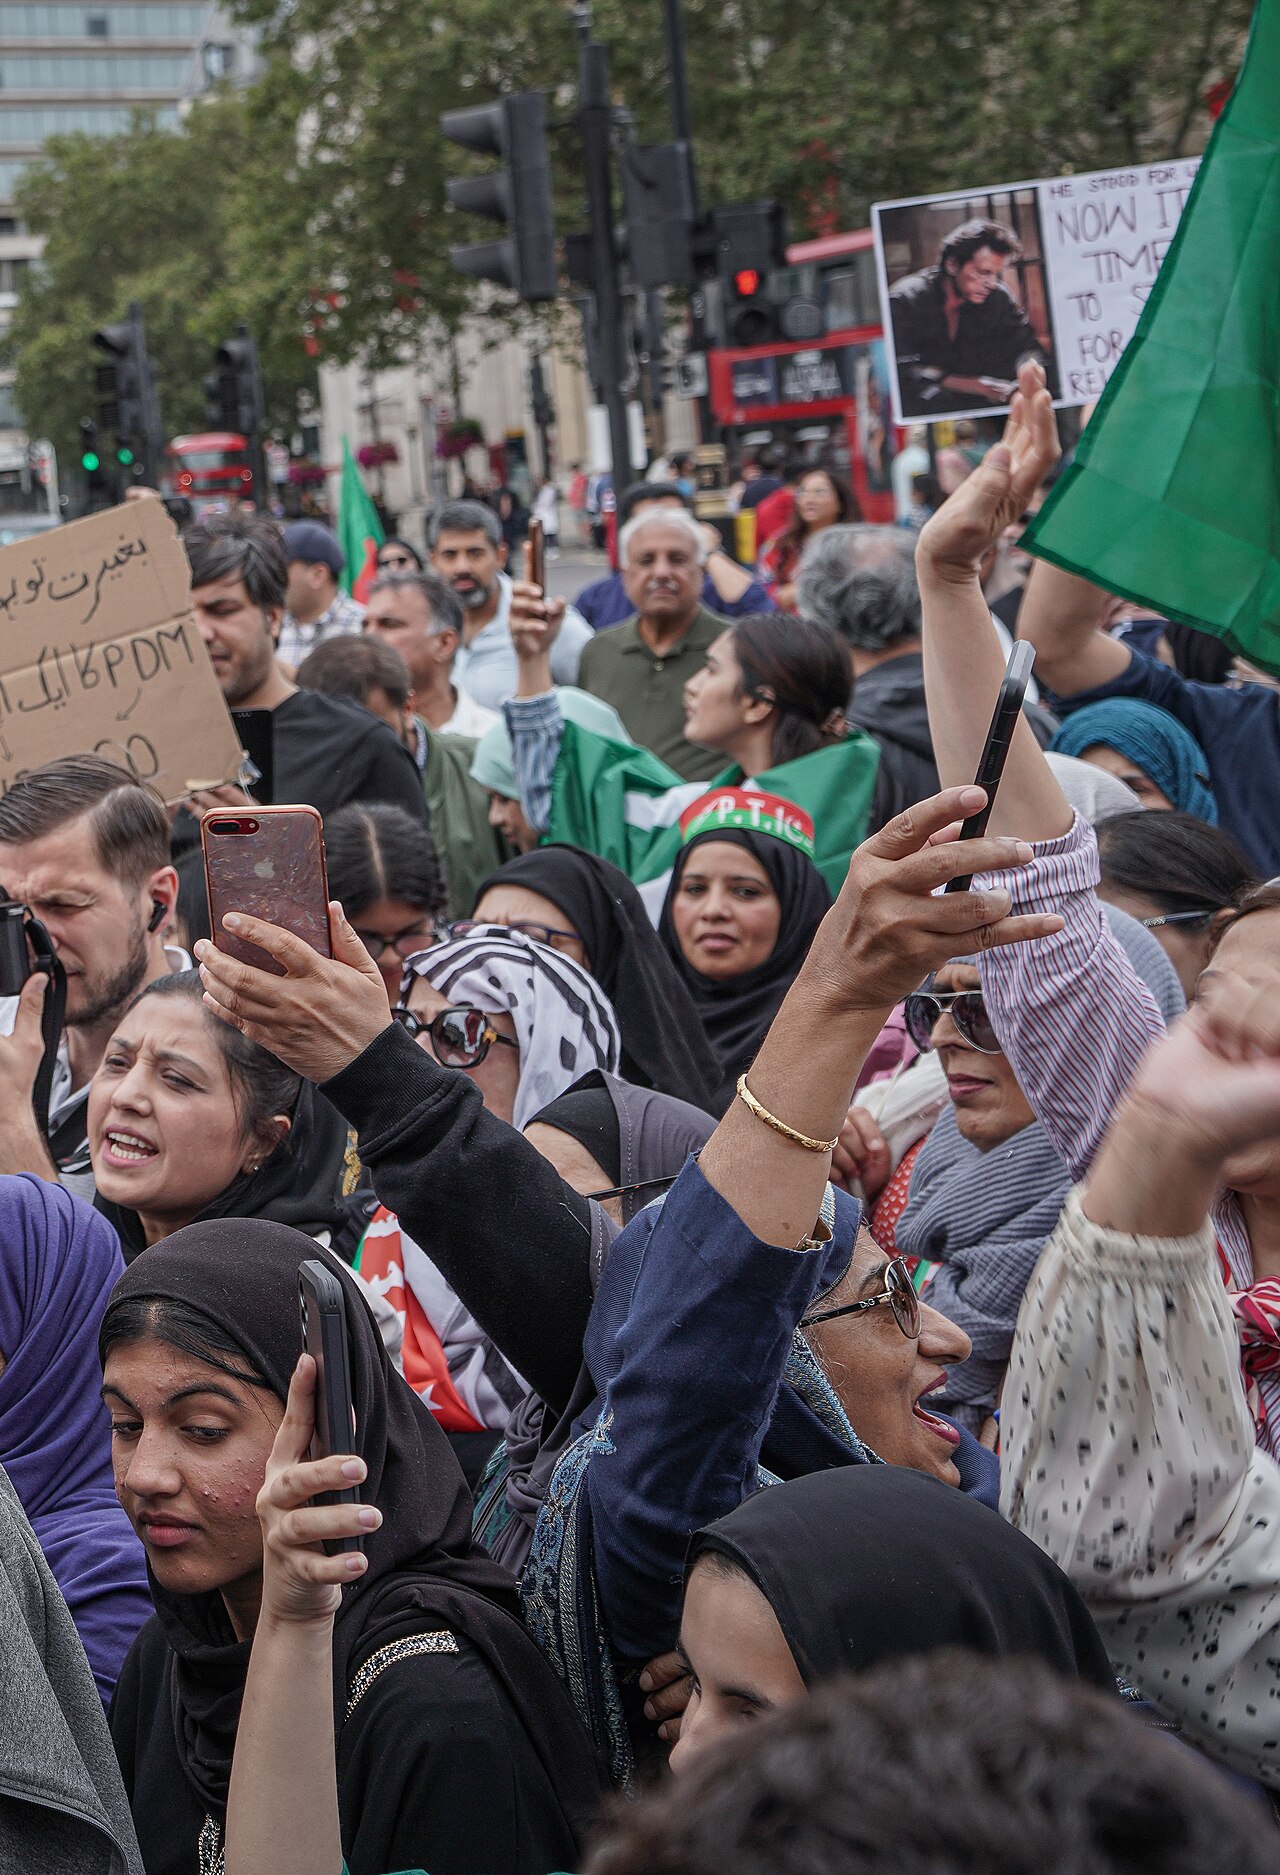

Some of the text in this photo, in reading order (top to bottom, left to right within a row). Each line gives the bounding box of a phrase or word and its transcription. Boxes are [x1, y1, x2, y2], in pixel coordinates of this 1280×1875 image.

[1049, 182, 1074, 199] HE
[1089, 173, 1138, 193] STOOD
[1148, 167, 1175, 186] FOR
[1056, 194, 1138, 246] NOW
[1066, 291, 1103, 323] TO
[1078, 329, 1125, 367] FOR
[102, 624, 194, 688] PDM
